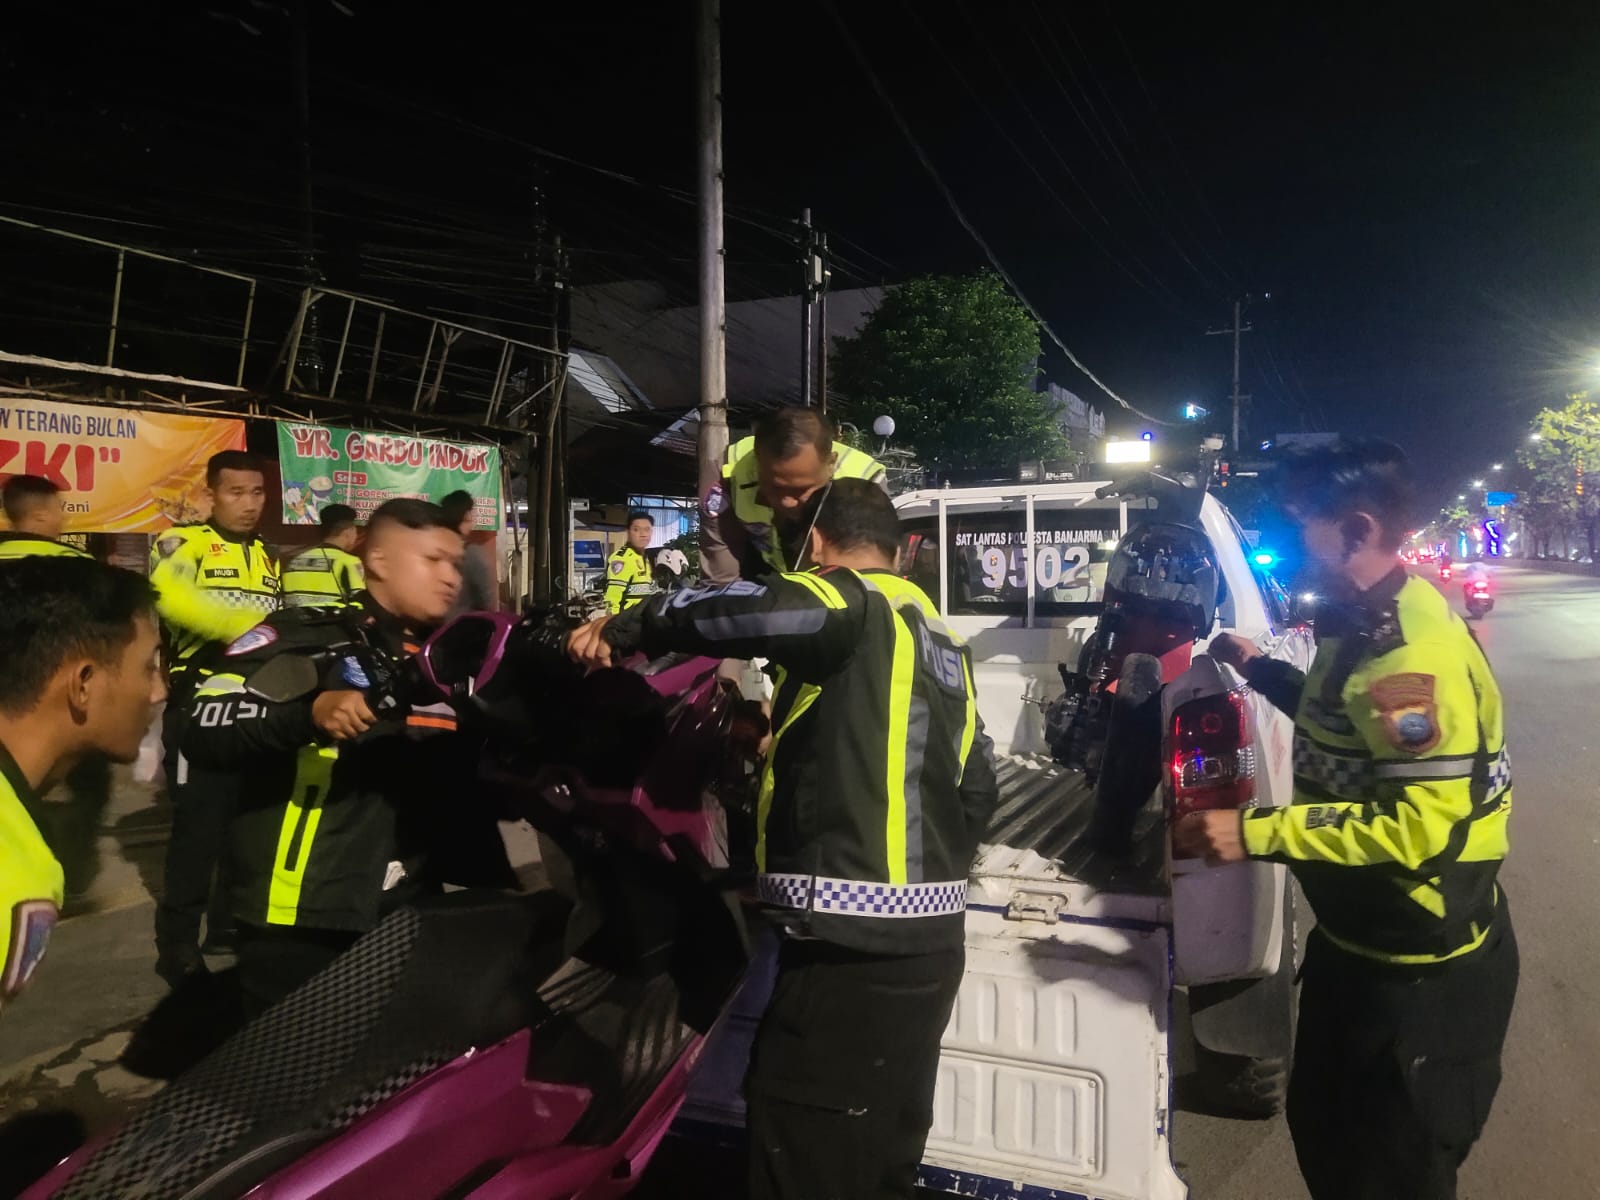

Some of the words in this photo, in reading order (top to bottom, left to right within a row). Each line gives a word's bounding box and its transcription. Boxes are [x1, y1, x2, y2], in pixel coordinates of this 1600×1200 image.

[16, 409, 81, 435] TERANG
[86, 416, 136, 439] BULAN
[291, 428, 340, 460] WR.
[345, 431, 423, 467] GARDU
[428, 442, 489, 473] INDUK
[956, 533, 972, 546] SAT
[973, 532, 1006, 545] LANTAS
[1008, 530, 1052, 545] POLESTA
[1055, 529, 1119, 544] BANJARMASIN
[981, 546, 1090, 588] 9502
